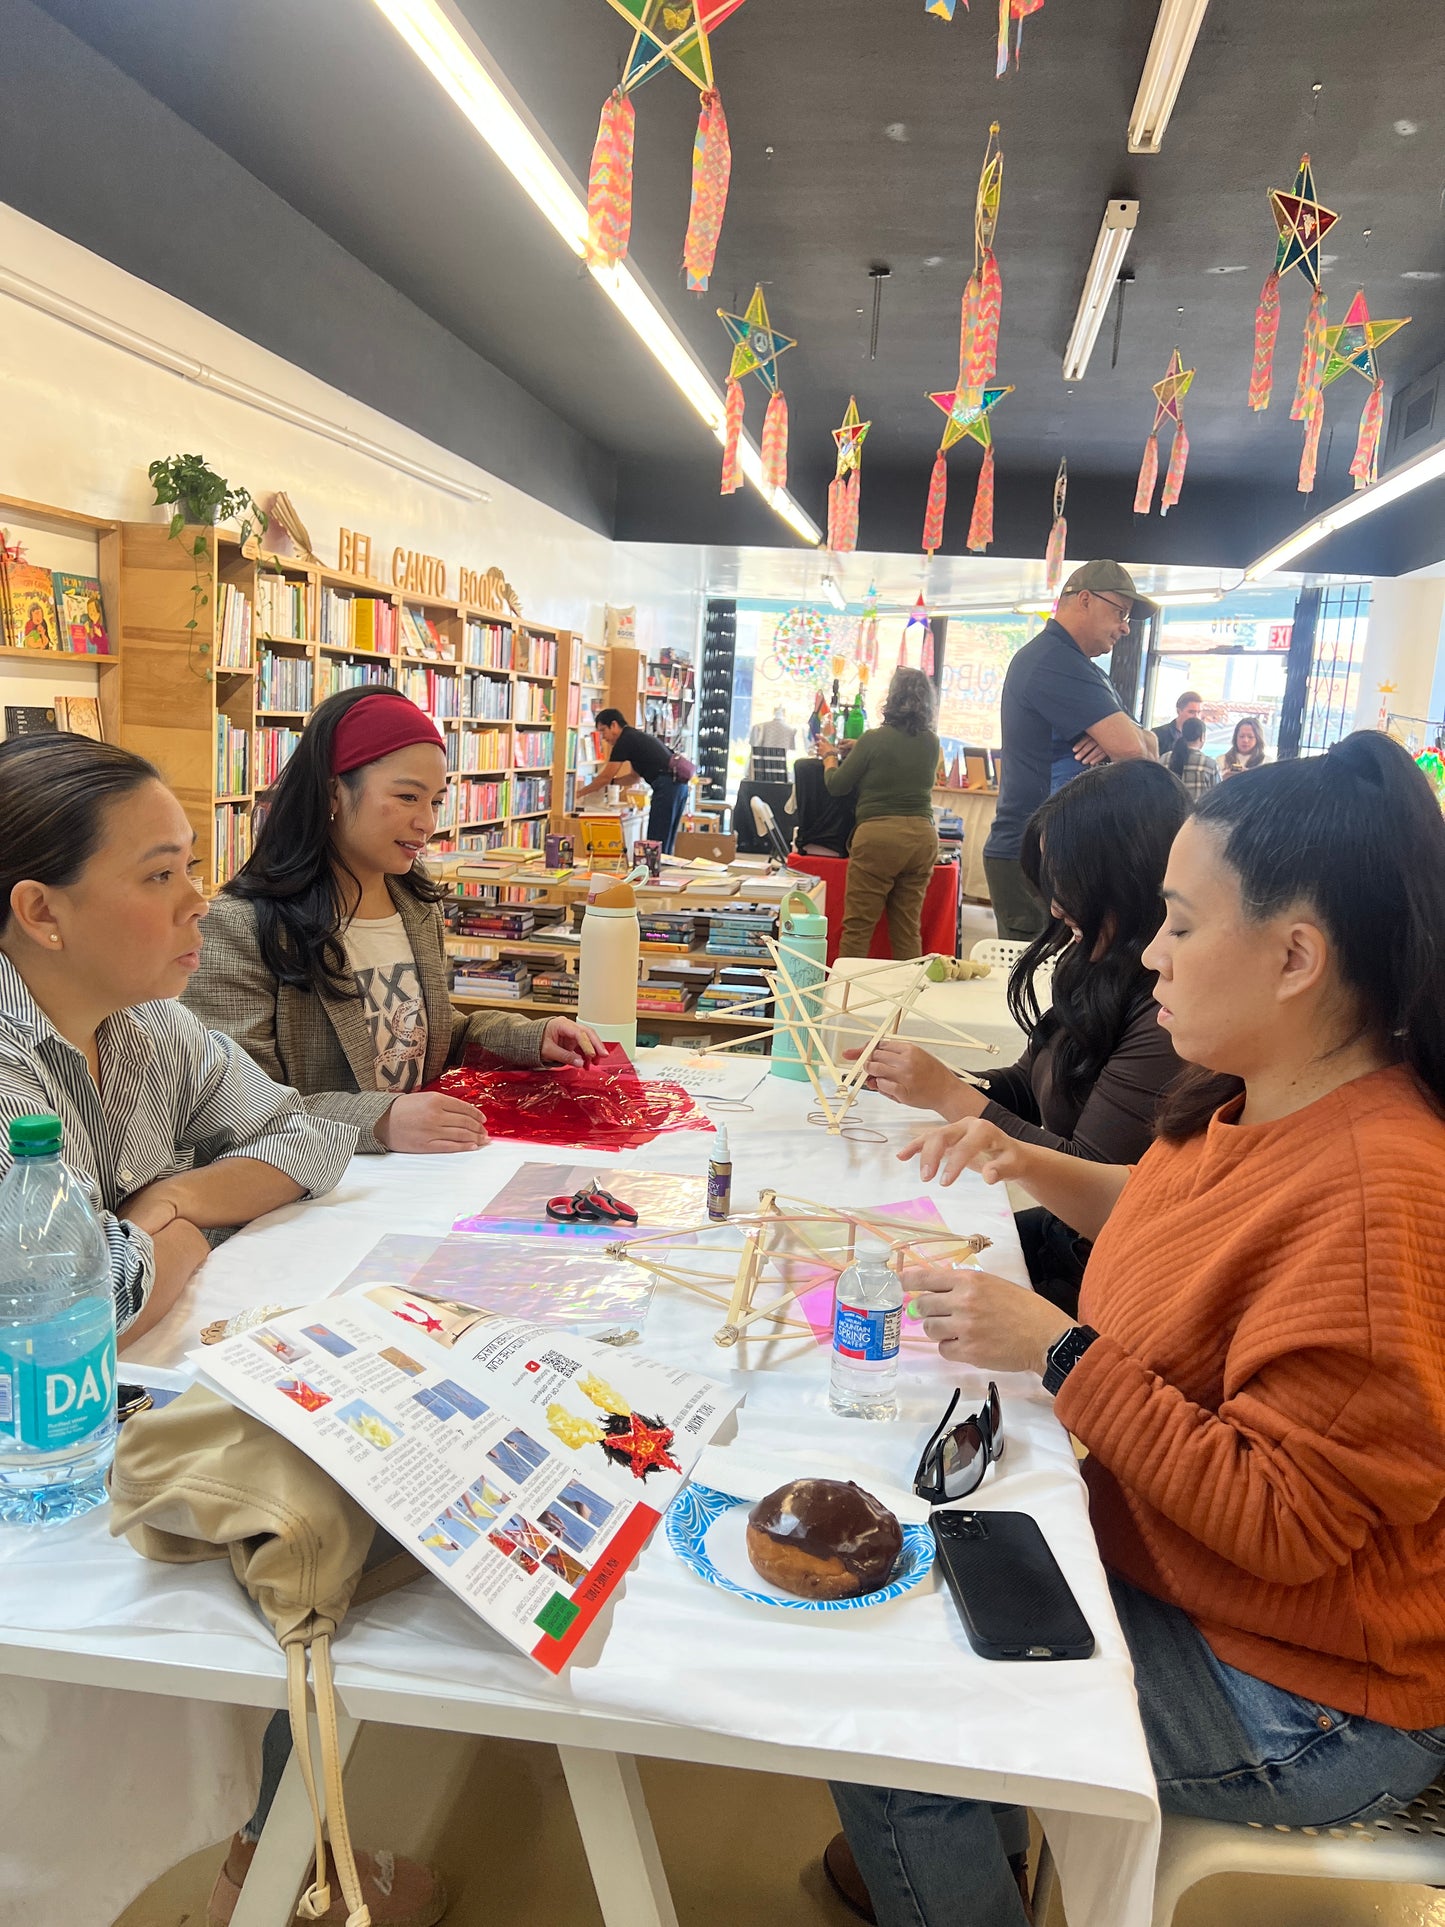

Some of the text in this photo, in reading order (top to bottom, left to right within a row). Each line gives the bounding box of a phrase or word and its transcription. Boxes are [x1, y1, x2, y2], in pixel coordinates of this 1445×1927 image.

[339, 527, 506, 612] BEL CANTO BOOKS
[1269, 626, 1292, 648] EXI
[656, 1071, 726, 1083] ACTIVITY
[838, 1320, 871, 1333] MOUNTAIN
[837, 1326, 871, 1343] SPRING
[842, 1339, 864, 1348] WATER
[500, 1346, 515, 1361] THE
[486, 1356, 503, 1373] FUN
[529, 1383, 548, 1404] different
[540, 1392, 552, 1406] code
[683, 1412, 706, 1436] MAKING
[601, 1564, 613, 1577] TO
[606, 1556, 619, 1570] HOW
[594, 1571, 608, 1587] MAKE
